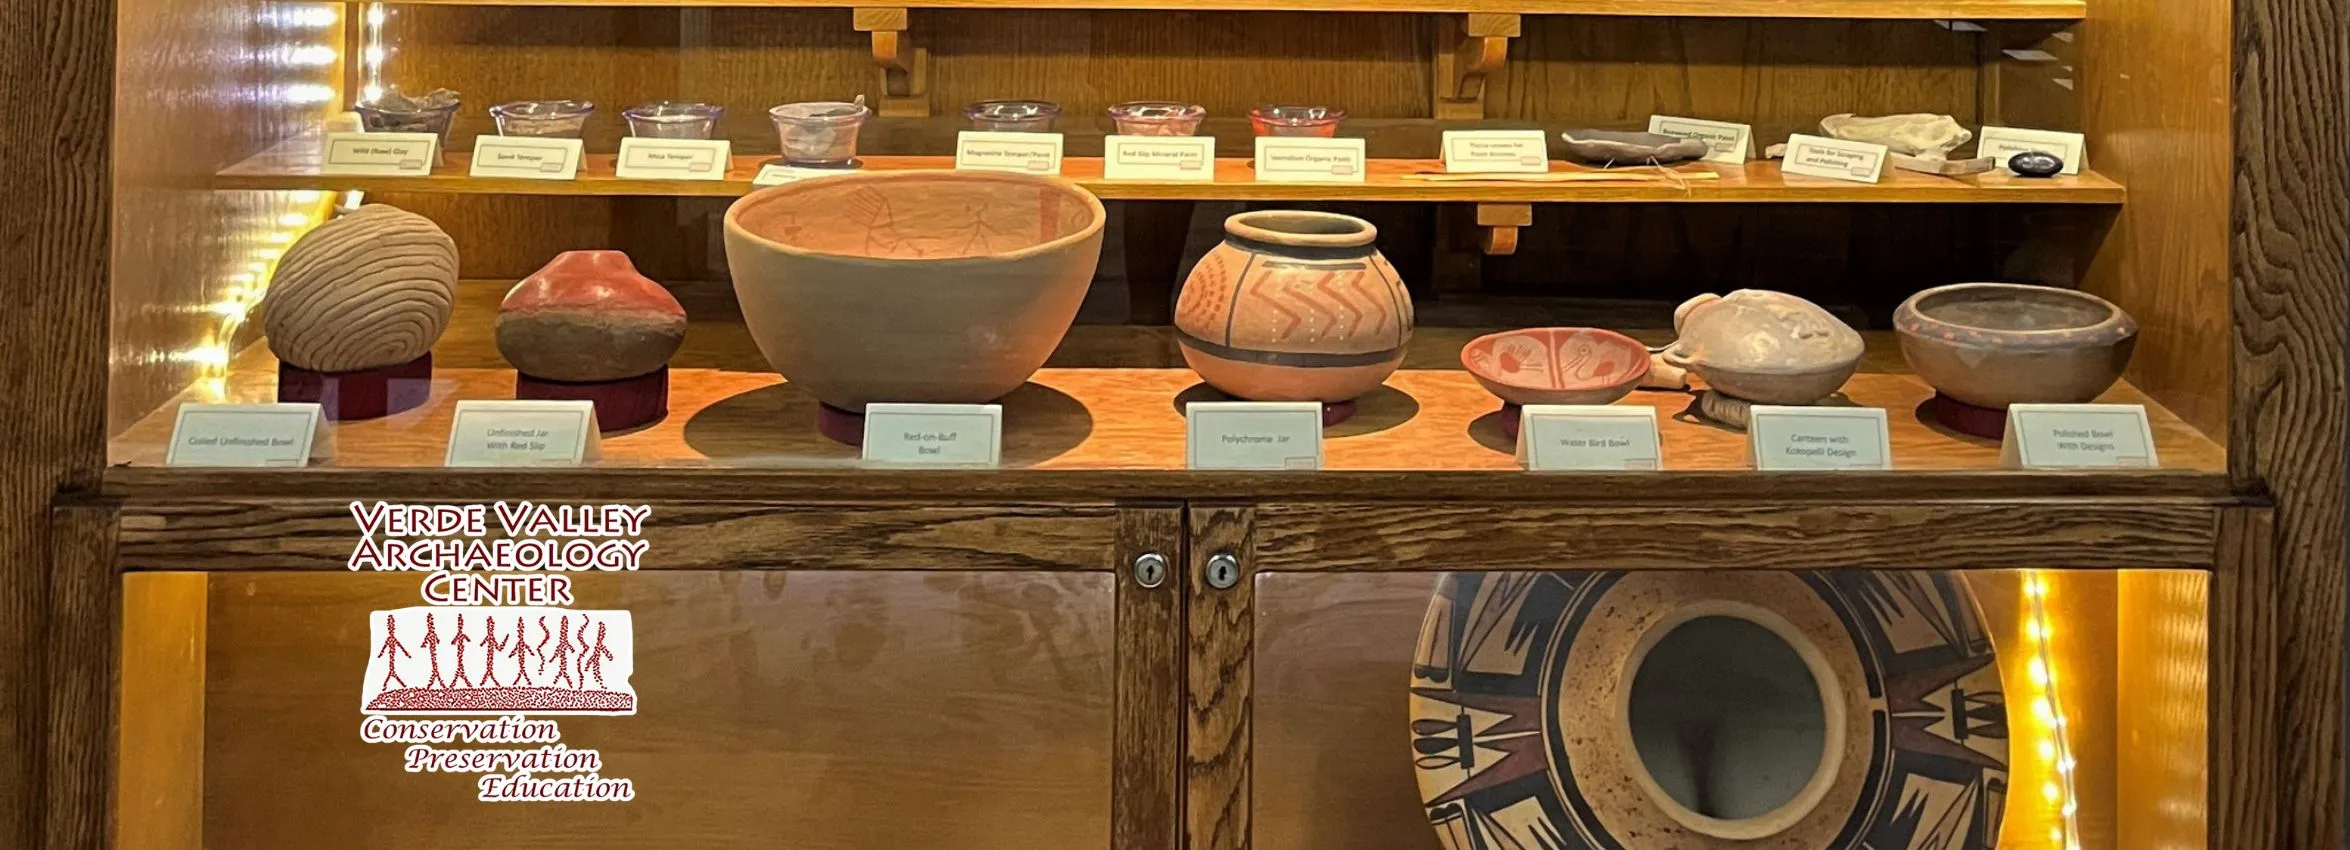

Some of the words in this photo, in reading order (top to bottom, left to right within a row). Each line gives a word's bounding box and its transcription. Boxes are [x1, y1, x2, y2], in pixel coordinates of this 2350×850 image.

[517, 153, 543, 161] Temper
[1819, 158, 1848, 168] Polishing
[487, 428, 535, 438] Unfinished
[536, 429, 550, 438] Jar
[904, 432, 957, 441] Red-on-Buff
[2053, 428, 2089, 438] Polished
[2092, 429, 2113, 438] Bowl
[188, 436, 218, 445] Coiled
[220, 437, 269, 446] Unfinished
[271, 437, 294, 446] Bowl
[1221, 434, 1273, 444] Polychrome
[1560, 439, 1586, 447] Water
[1588, 439, 1606, 447] Bird
[1609, 439, 1630, 447] Bowl
[1790, 434, 1827, 444] Canteen
[1829, 435, 1848, 444] with
[487, 441, 508, 450] With
[510, 441, 527, 450] Red
[529, 441, 545, 451] Slip
[919, 446, 940, 454] Bowl
[2057, 442, 2079, 450] With
[2080, 442, 2115, 452] Designs
[1786, 446, 1825, 457] Kokopelli
[1827, 447, 1857, 458] Design
